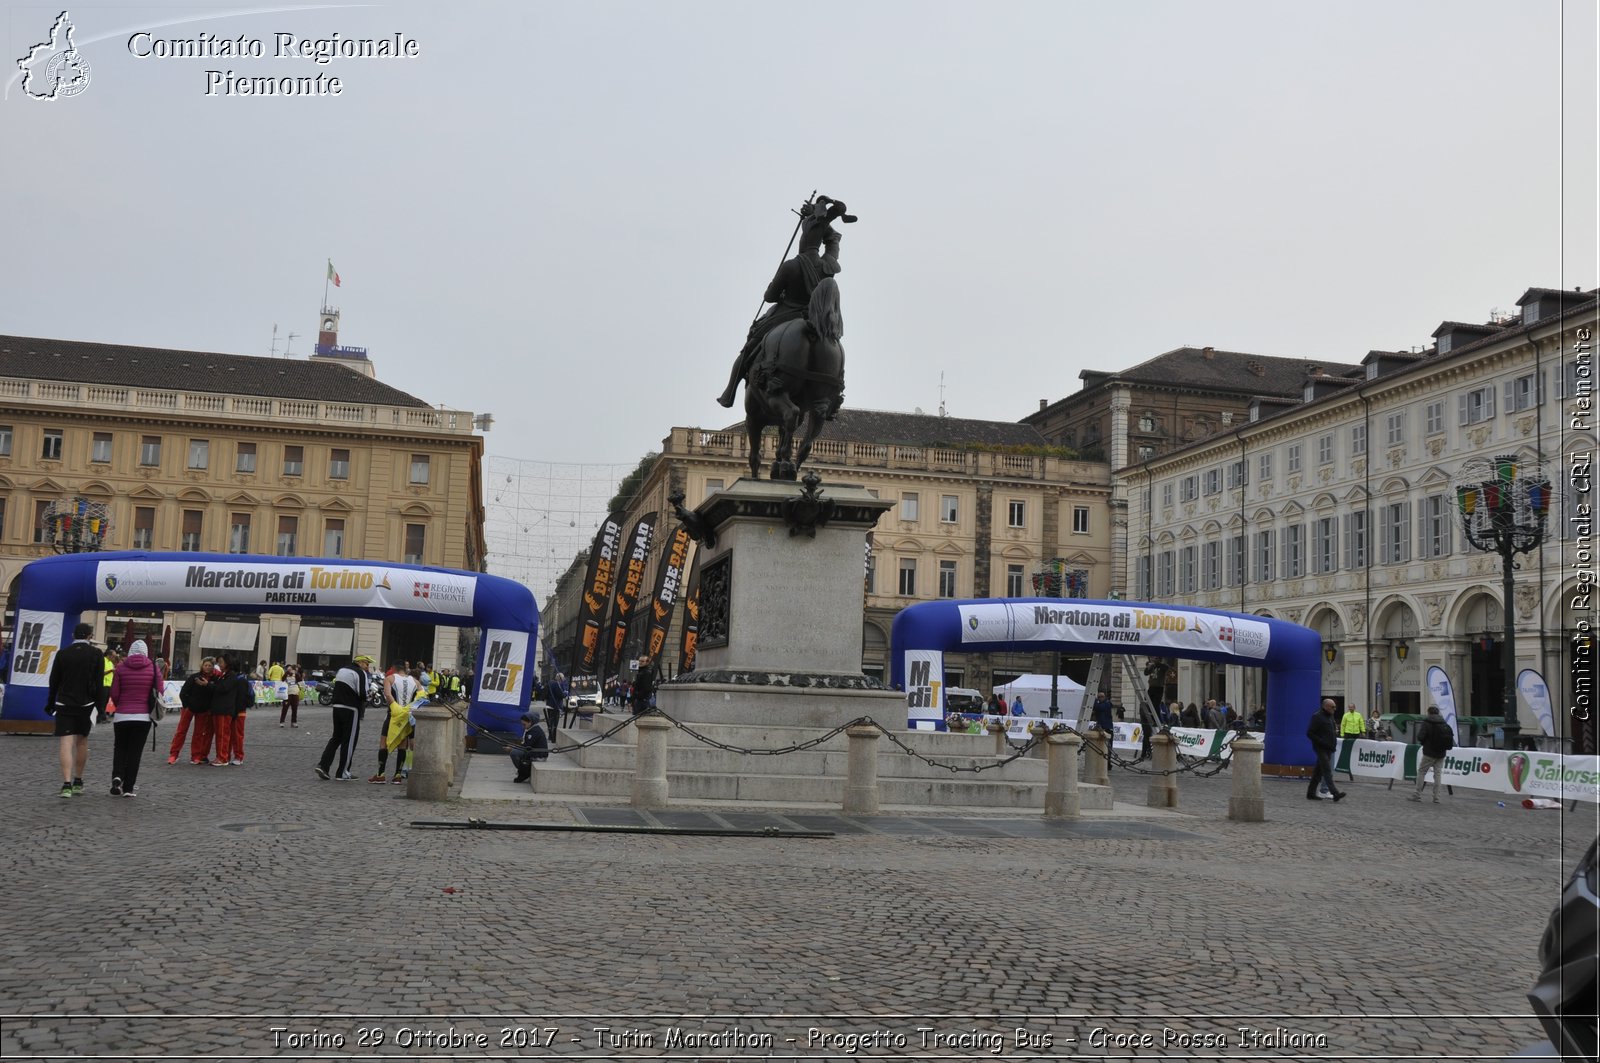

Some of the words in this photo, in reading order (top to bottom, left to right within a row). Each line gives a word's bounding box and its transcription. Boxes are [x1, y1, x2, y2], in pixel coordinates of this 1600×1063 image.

[593, 520, 618, 597] BEEBAD
[624, 522, 649, 597] BEEBAD
[185, 565, 279, 589] Maratona
[282, 570, 305, 589] di
[310, 567, 374, 590] Torino
[430, 583, 467, 595] REGIONE
[265, 592, 317, 603] PARTENZA
[430, 591, 466, 603] PIEMONTE
[1034, 606, 1110, 628] Maratona
[1112, 612, 1131, 629] di
[1133, 609, 1187, 633] Torino
[18, 621, 44, 650] M
[1097, 629, 1140, 643] PARTENZA
[1233, 629, 1264, 640] REGIONE
[13, 644, 58, 675] diT
[487, 640, 512, 669] M
[481, 663, 523, 693] diT
[909, 660, 931, 686] M
[908, 680, 942, 708] diT
[1174, 733, 1205, 747] ttaglio
[1358, 748, 1396, 767] battaglio
[1444, 756, 1491, 775] ttaglio
[1560, 783, 1583, 793] AGNI
